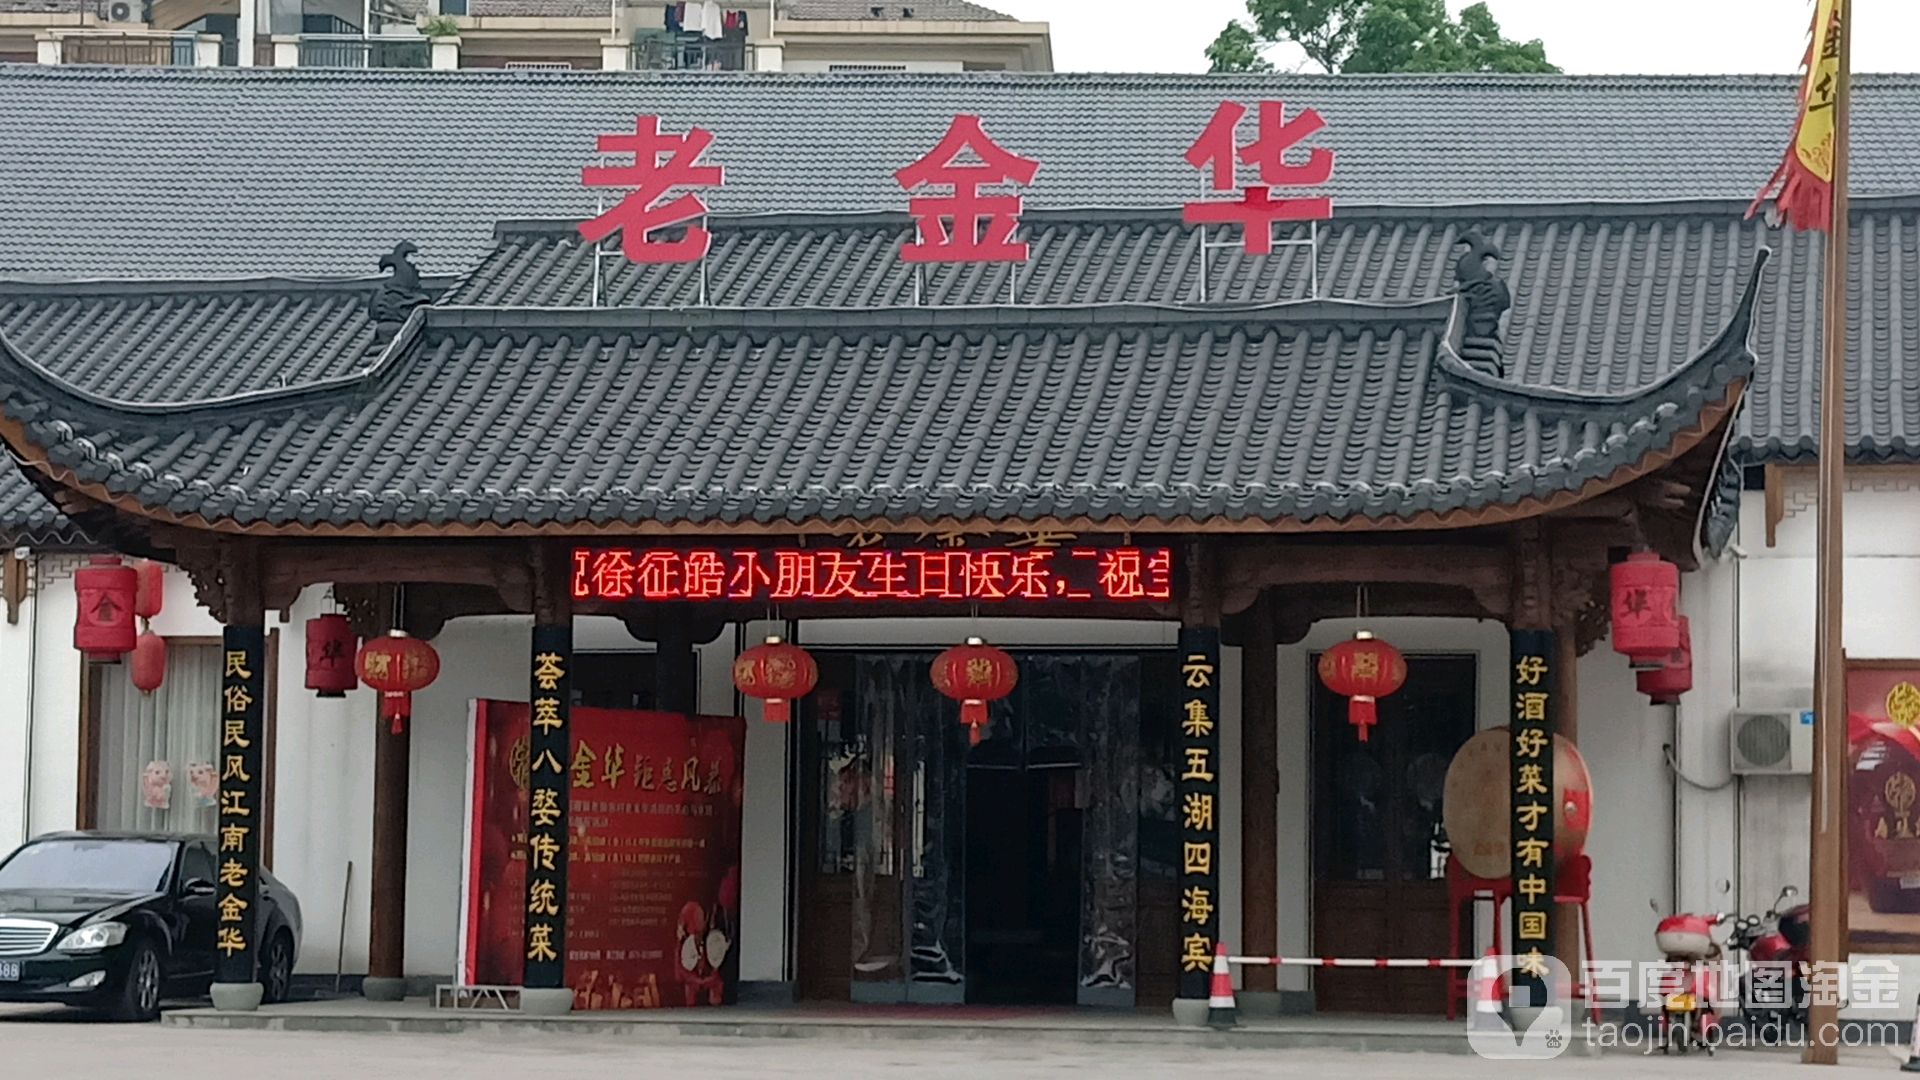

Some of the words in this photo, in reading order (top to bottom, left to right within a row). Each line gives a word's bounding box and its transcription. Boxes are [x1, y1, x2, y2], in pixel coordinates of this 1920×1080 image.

[580, 101, 1334, 263] 老金华
[217, 651, 252, 957] 民俗民风江南老金华
[528, 653, 565, 962] 荟萃八婺传统菜
[1182, 655, 1214, 972] 云集五湖四海宾
[1516, 655, 1549, 978] 好酒好菜才有中国味
